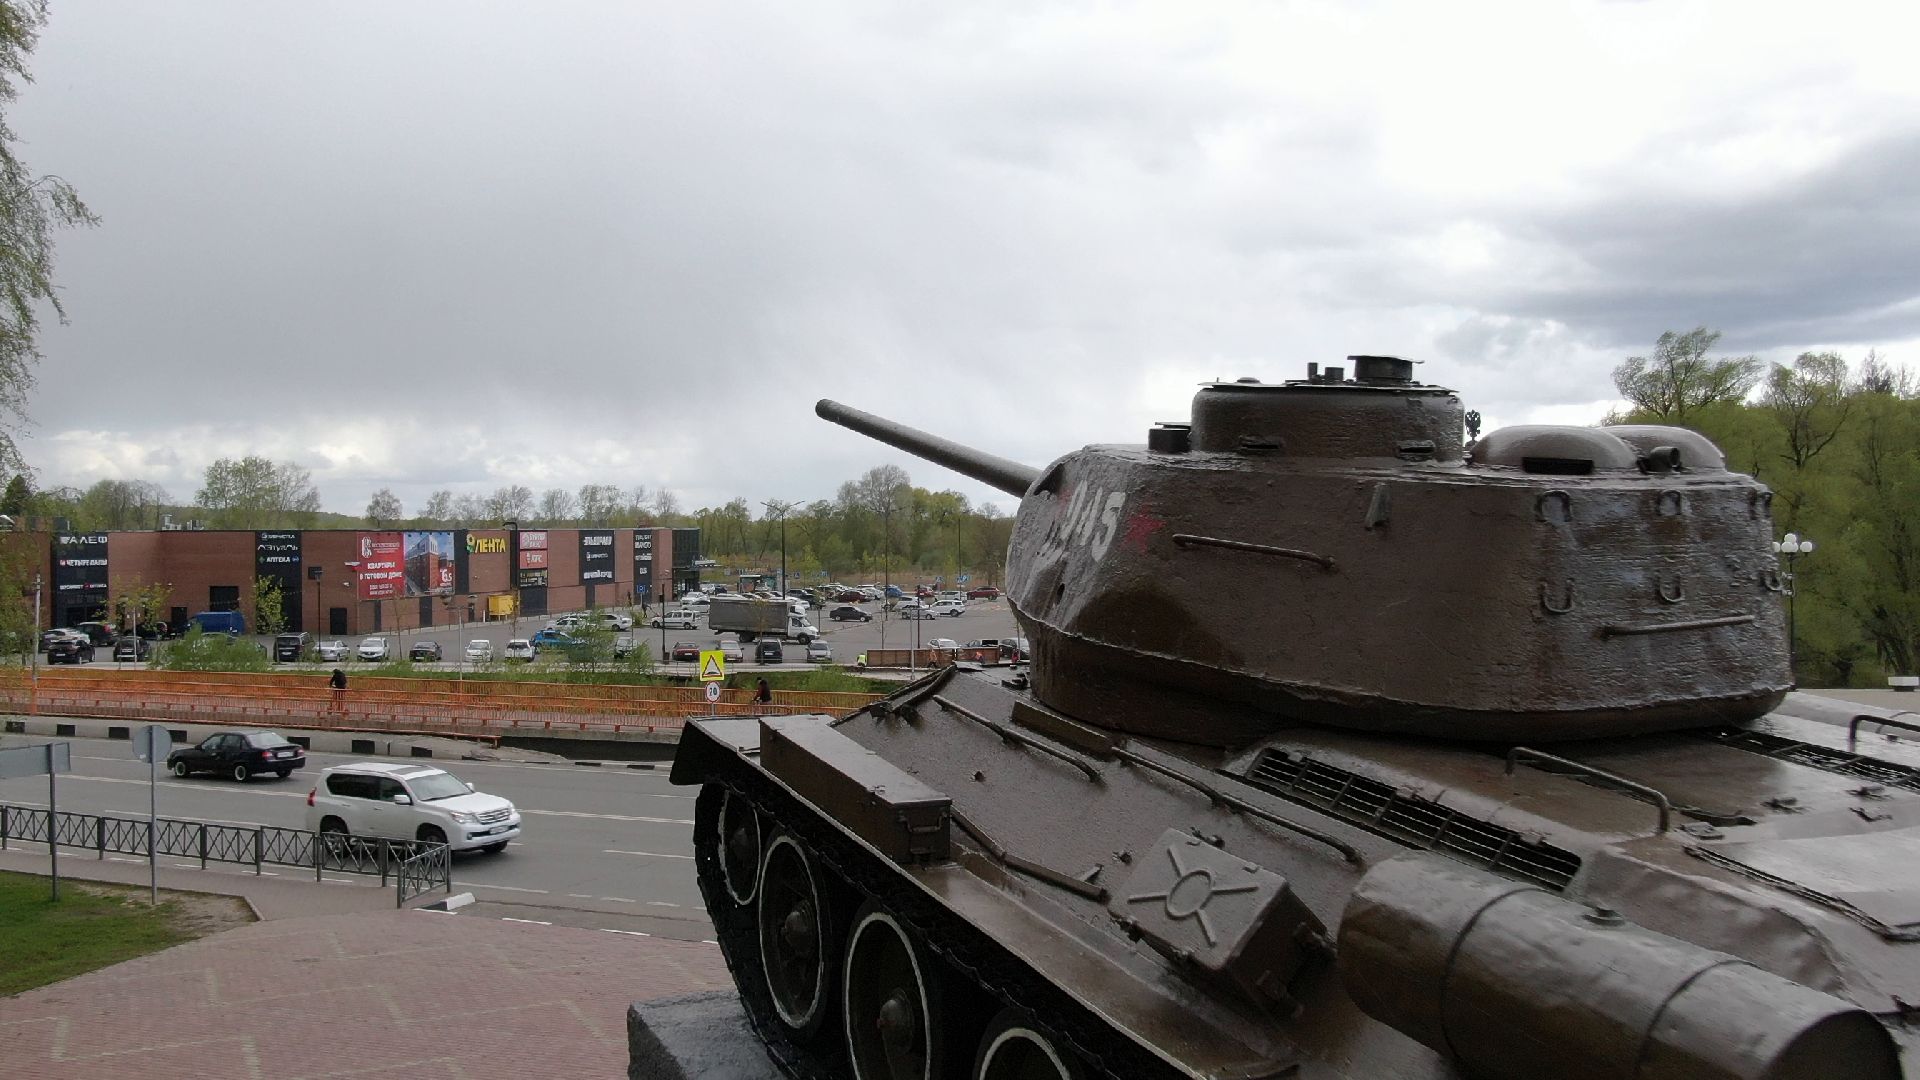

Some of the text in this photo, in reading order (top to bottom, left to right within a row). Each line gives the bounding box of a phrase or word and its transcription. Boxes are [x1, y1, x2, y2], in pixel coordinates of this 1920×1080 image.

[475, 537, 506, 553] ЛЕНТА
[364, 571, 388, 580] ГОТОВОМ
[388, 571, 403, 580] ДОМЕ
